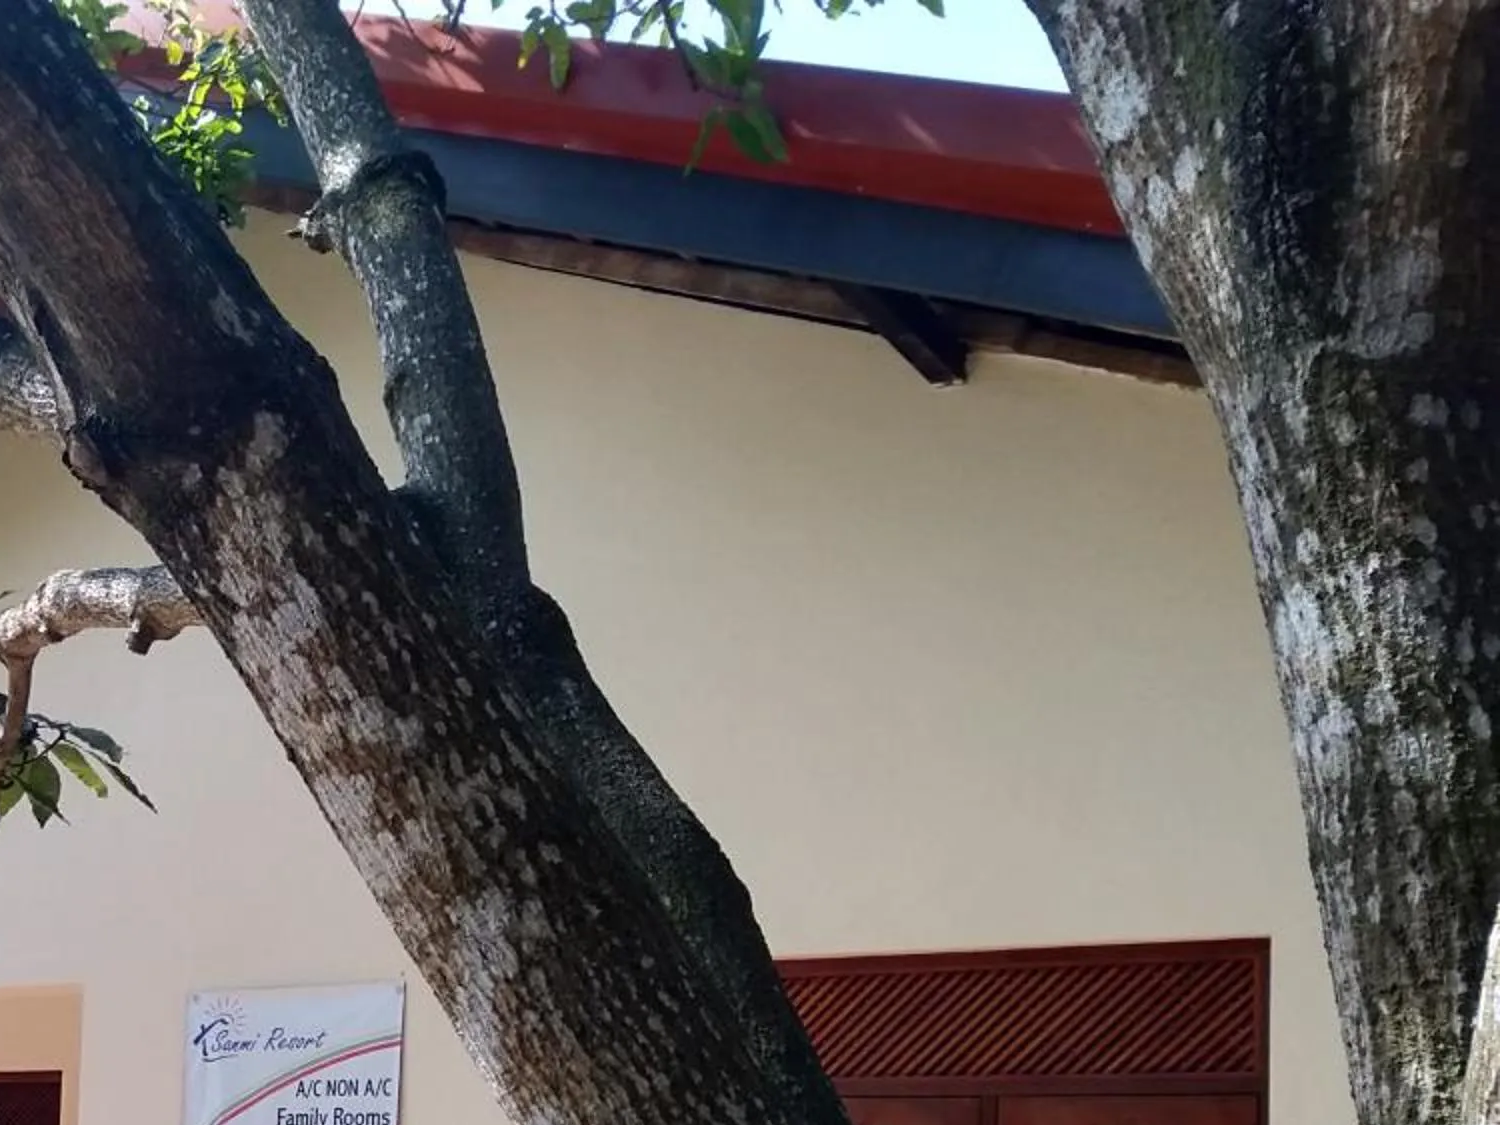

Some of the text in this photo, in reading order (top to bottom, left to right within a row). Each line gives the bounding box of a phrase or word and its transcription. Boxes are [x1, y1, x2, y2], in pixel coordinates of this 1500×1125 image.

[264, 1027, 326, 1051] Resort
[295, 1077, 392, 1098] A/C NON A/C
